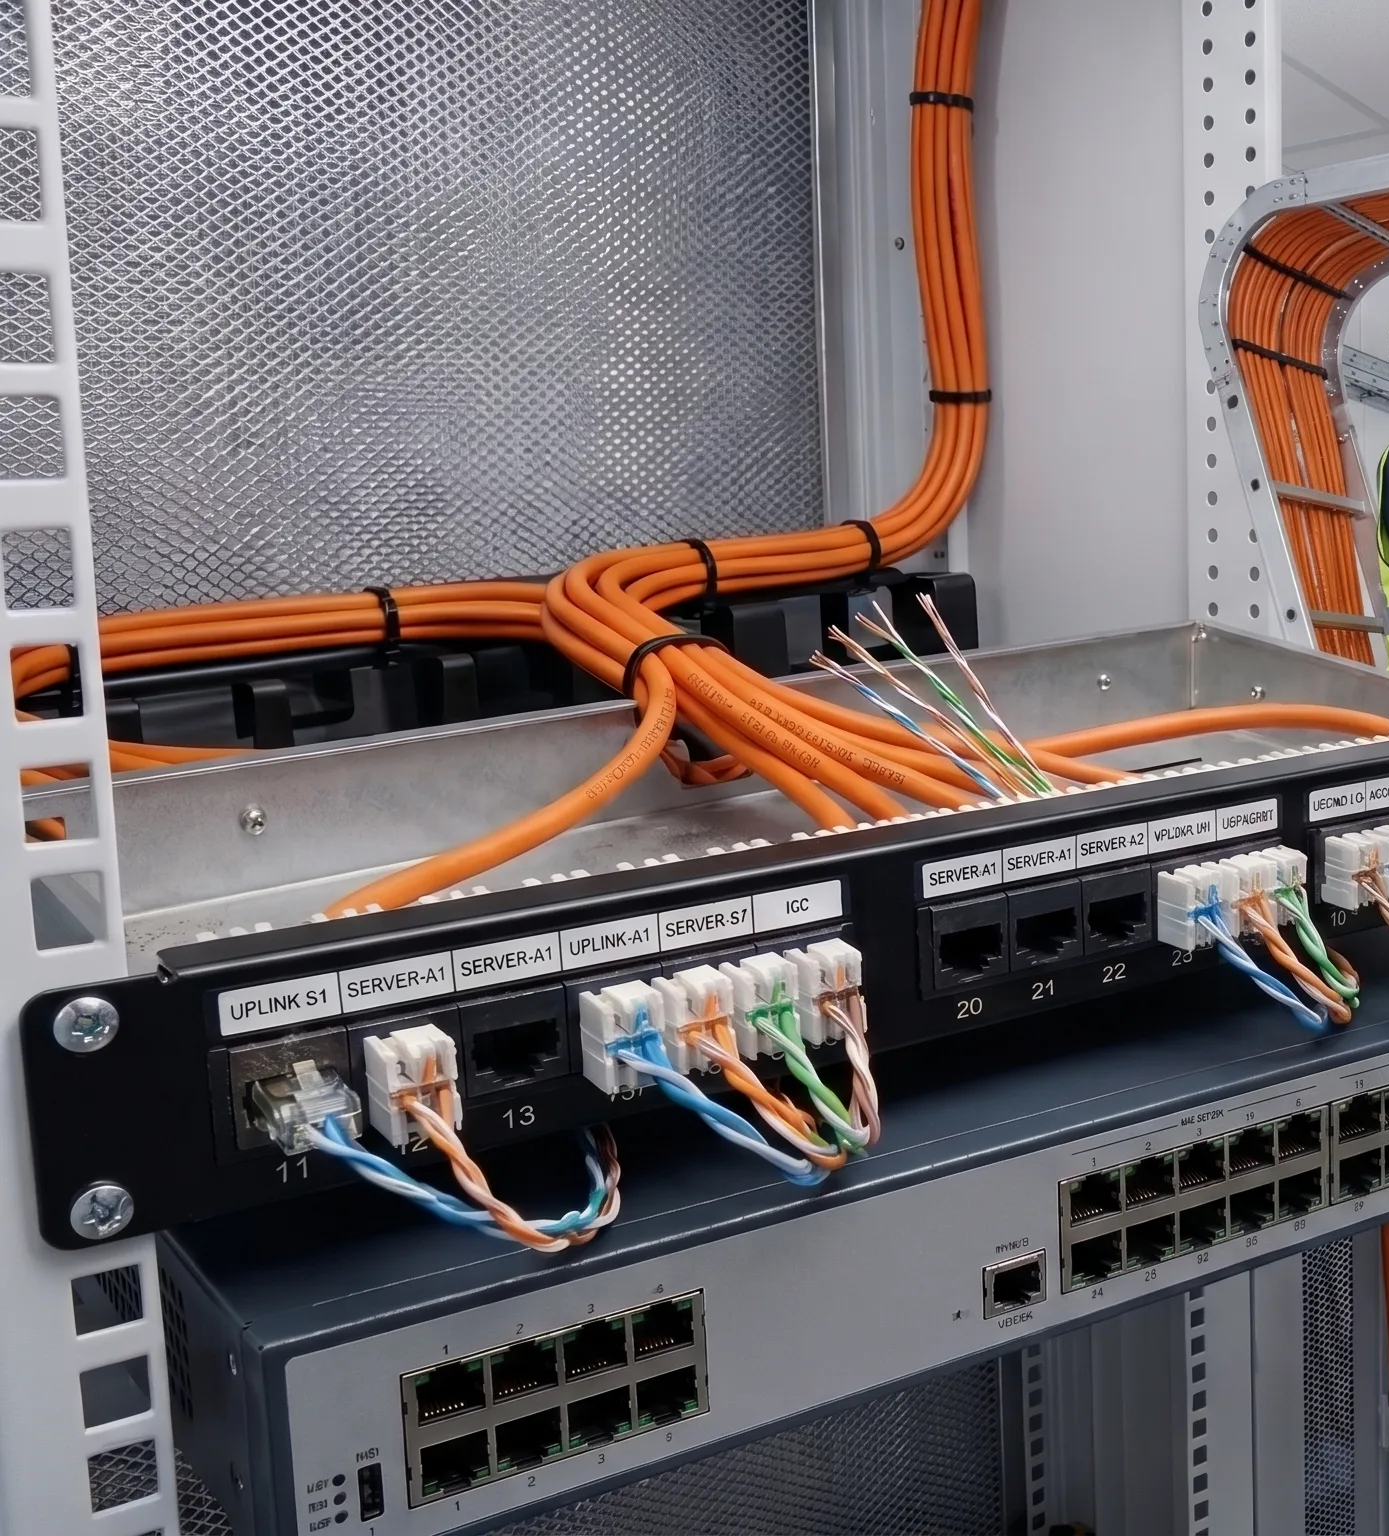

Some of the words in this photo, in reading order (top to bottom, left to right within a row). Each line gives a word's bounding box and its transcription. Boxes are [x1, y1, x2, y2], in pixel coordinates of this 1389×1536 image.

[786, 898, 810, 915] IGC
[1331, 910, 1346, 927] 10
[569, 927, 650, 956] UPLINK-A1
[460, 946, 553, 977] SERVER-A1
[347, 966, 446, 997] SERVER-A1
[1102, 963, 1126, 983] 22
[1031, 980, 1055, 1000] 21
[230, 994, 301, 1021] UPLINK
[306, 989, 328, 1006] S1
[957, 998, 983, 1019] 20
[501, 1105, 536, 1129] 13
[1197, 1128, 1203, 1137] 3
[1145, 1142, 1152, 1151] 2
[276, 1157, 308, 1183] 11
[588, 1304, 595, 1314] 3
[516, 1323, 524, 1335] 2
[442, 1344, 449, 1355] 1
[598, 1454, 605, 1464] 3
[527, 1476, 536, 1488] 2
[455, 1501, 461, 1512] 1
